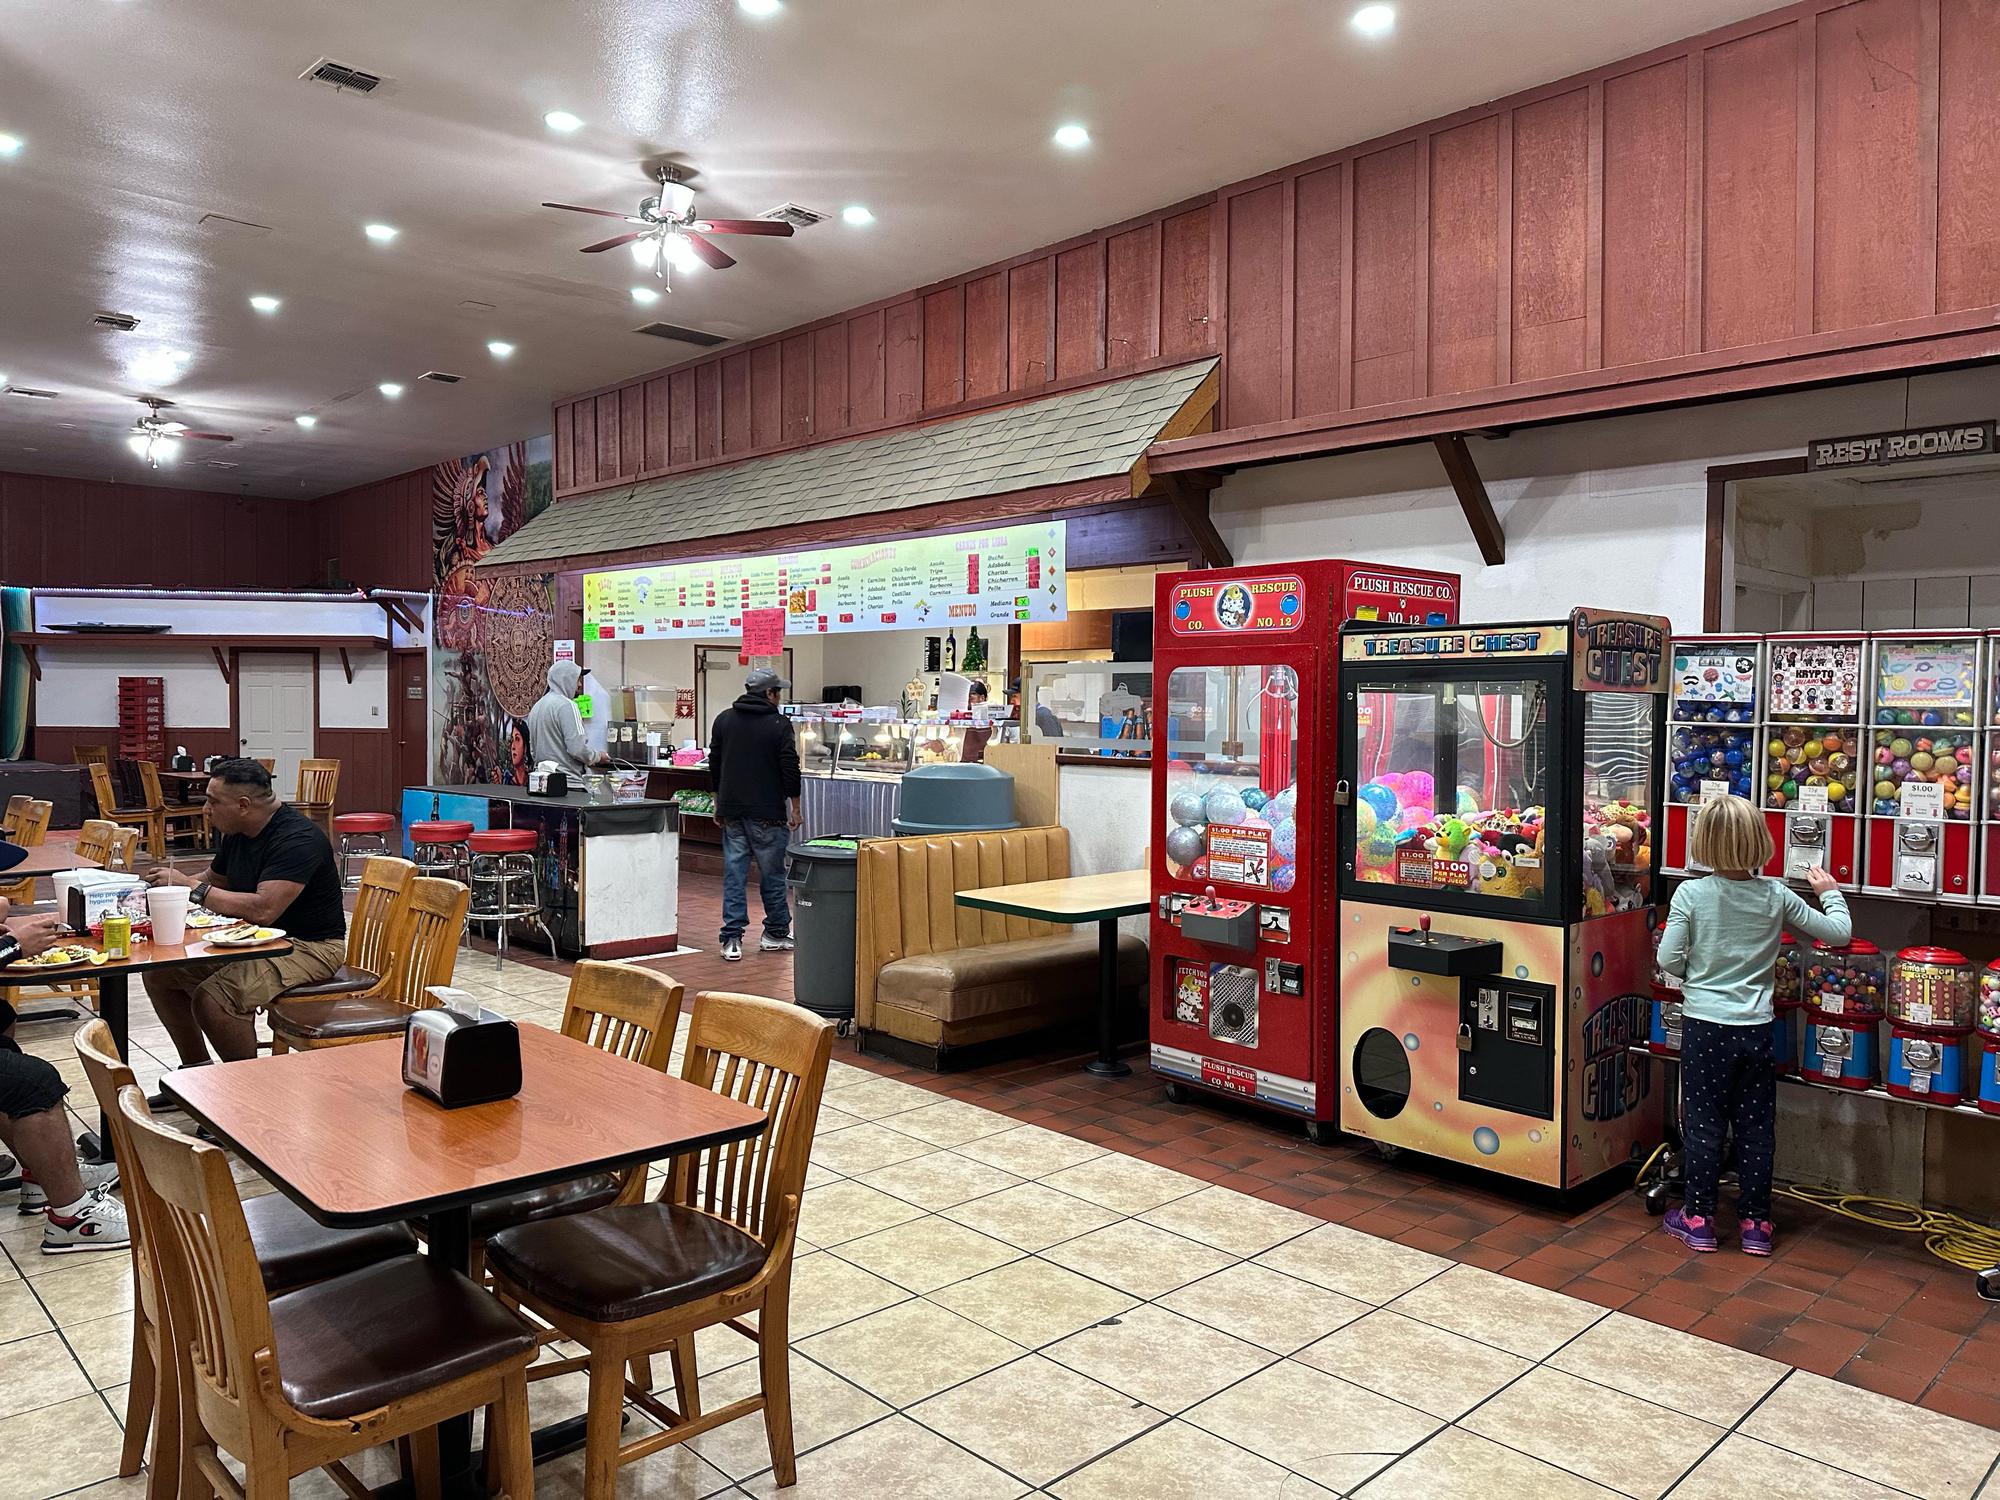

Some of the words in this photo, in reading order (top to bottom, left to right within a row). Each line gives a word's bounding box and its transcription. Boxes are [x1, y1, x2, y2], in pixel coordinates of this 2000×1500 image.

[1816, 438, 1881, 465] REST
[1888, 427, 1984, 458] ROOMS
[1180, 588, 1214, 598] PLUSH
[1252, 582, 1297, 594] RESCUE
[1354, 577, 1390, 593] PLUSH
[1393, 582, 1434, 598] RESCUE
[1437, 586, 1452, 600] CO.
[949, 604, 976, 618] MENUDO
[1188, 620, 1204, 630] CO.
[1257, 616, 1276, 628] NO.
[1280, 617, 1292, 627] 12
[1388, 612, 1405, 624] NO.
[1410, 614, 1420, 625] 12
[1587, 621, 1662, 649] TREASURE
[1364, 636, 1464, 656] TREASURE
[1469, 633, 1540, 655] CHEST
[1585, 649, 1660, 687] CHEST
[1796, 670, 1834, 678] KRYPTO
[678, 692, 692, 700] FIRE
[1912, 784, 1932, 792] $1.00
[1212, 826, 1230, 834] $1.00
[1401, 852, 1424, 860] $1.00
[1434, 862, 1468, 873] $1.00
[1434, 870, 1448, 878] PER
[1449, 872, 1468, 880] PLAY
[1448, 878, 1468, 887] JUEGO
[1178, 967, 1196, 976] FETCH
[1197, 970, 1208, 978] YOU
[1194, 979, 1208, 988] PRIZ
[1204, 1062, 1225, 1074] PLUSH
[1226, 1066, 1255, 1080] RESCUE
[1212, 1076, 1223, 1086] CO.
[1224, 1080, 1237, 1090] NO.
[1238, 1083, 1246, 1092] 12
[1583, 1049, 1650, 1120] CHEST
